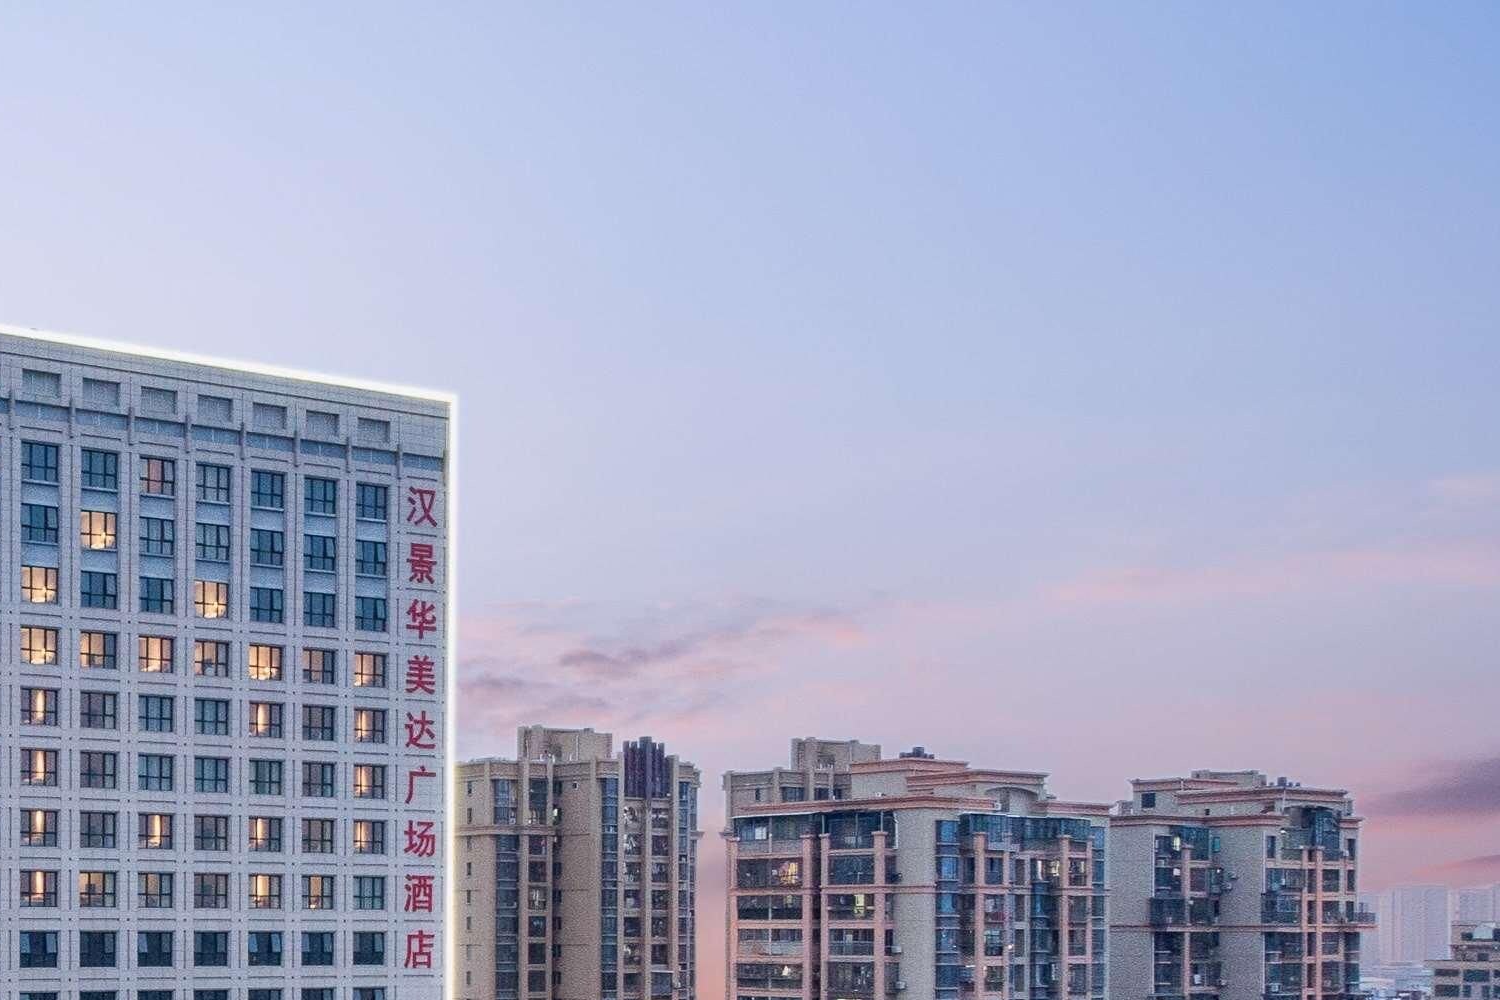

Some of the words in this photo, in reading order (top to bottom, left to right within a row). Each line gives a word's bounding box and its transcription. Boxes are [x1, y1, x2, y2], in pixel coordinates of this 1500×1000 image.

[404, 486, 438, 969] 汉景华美达广场酒店
